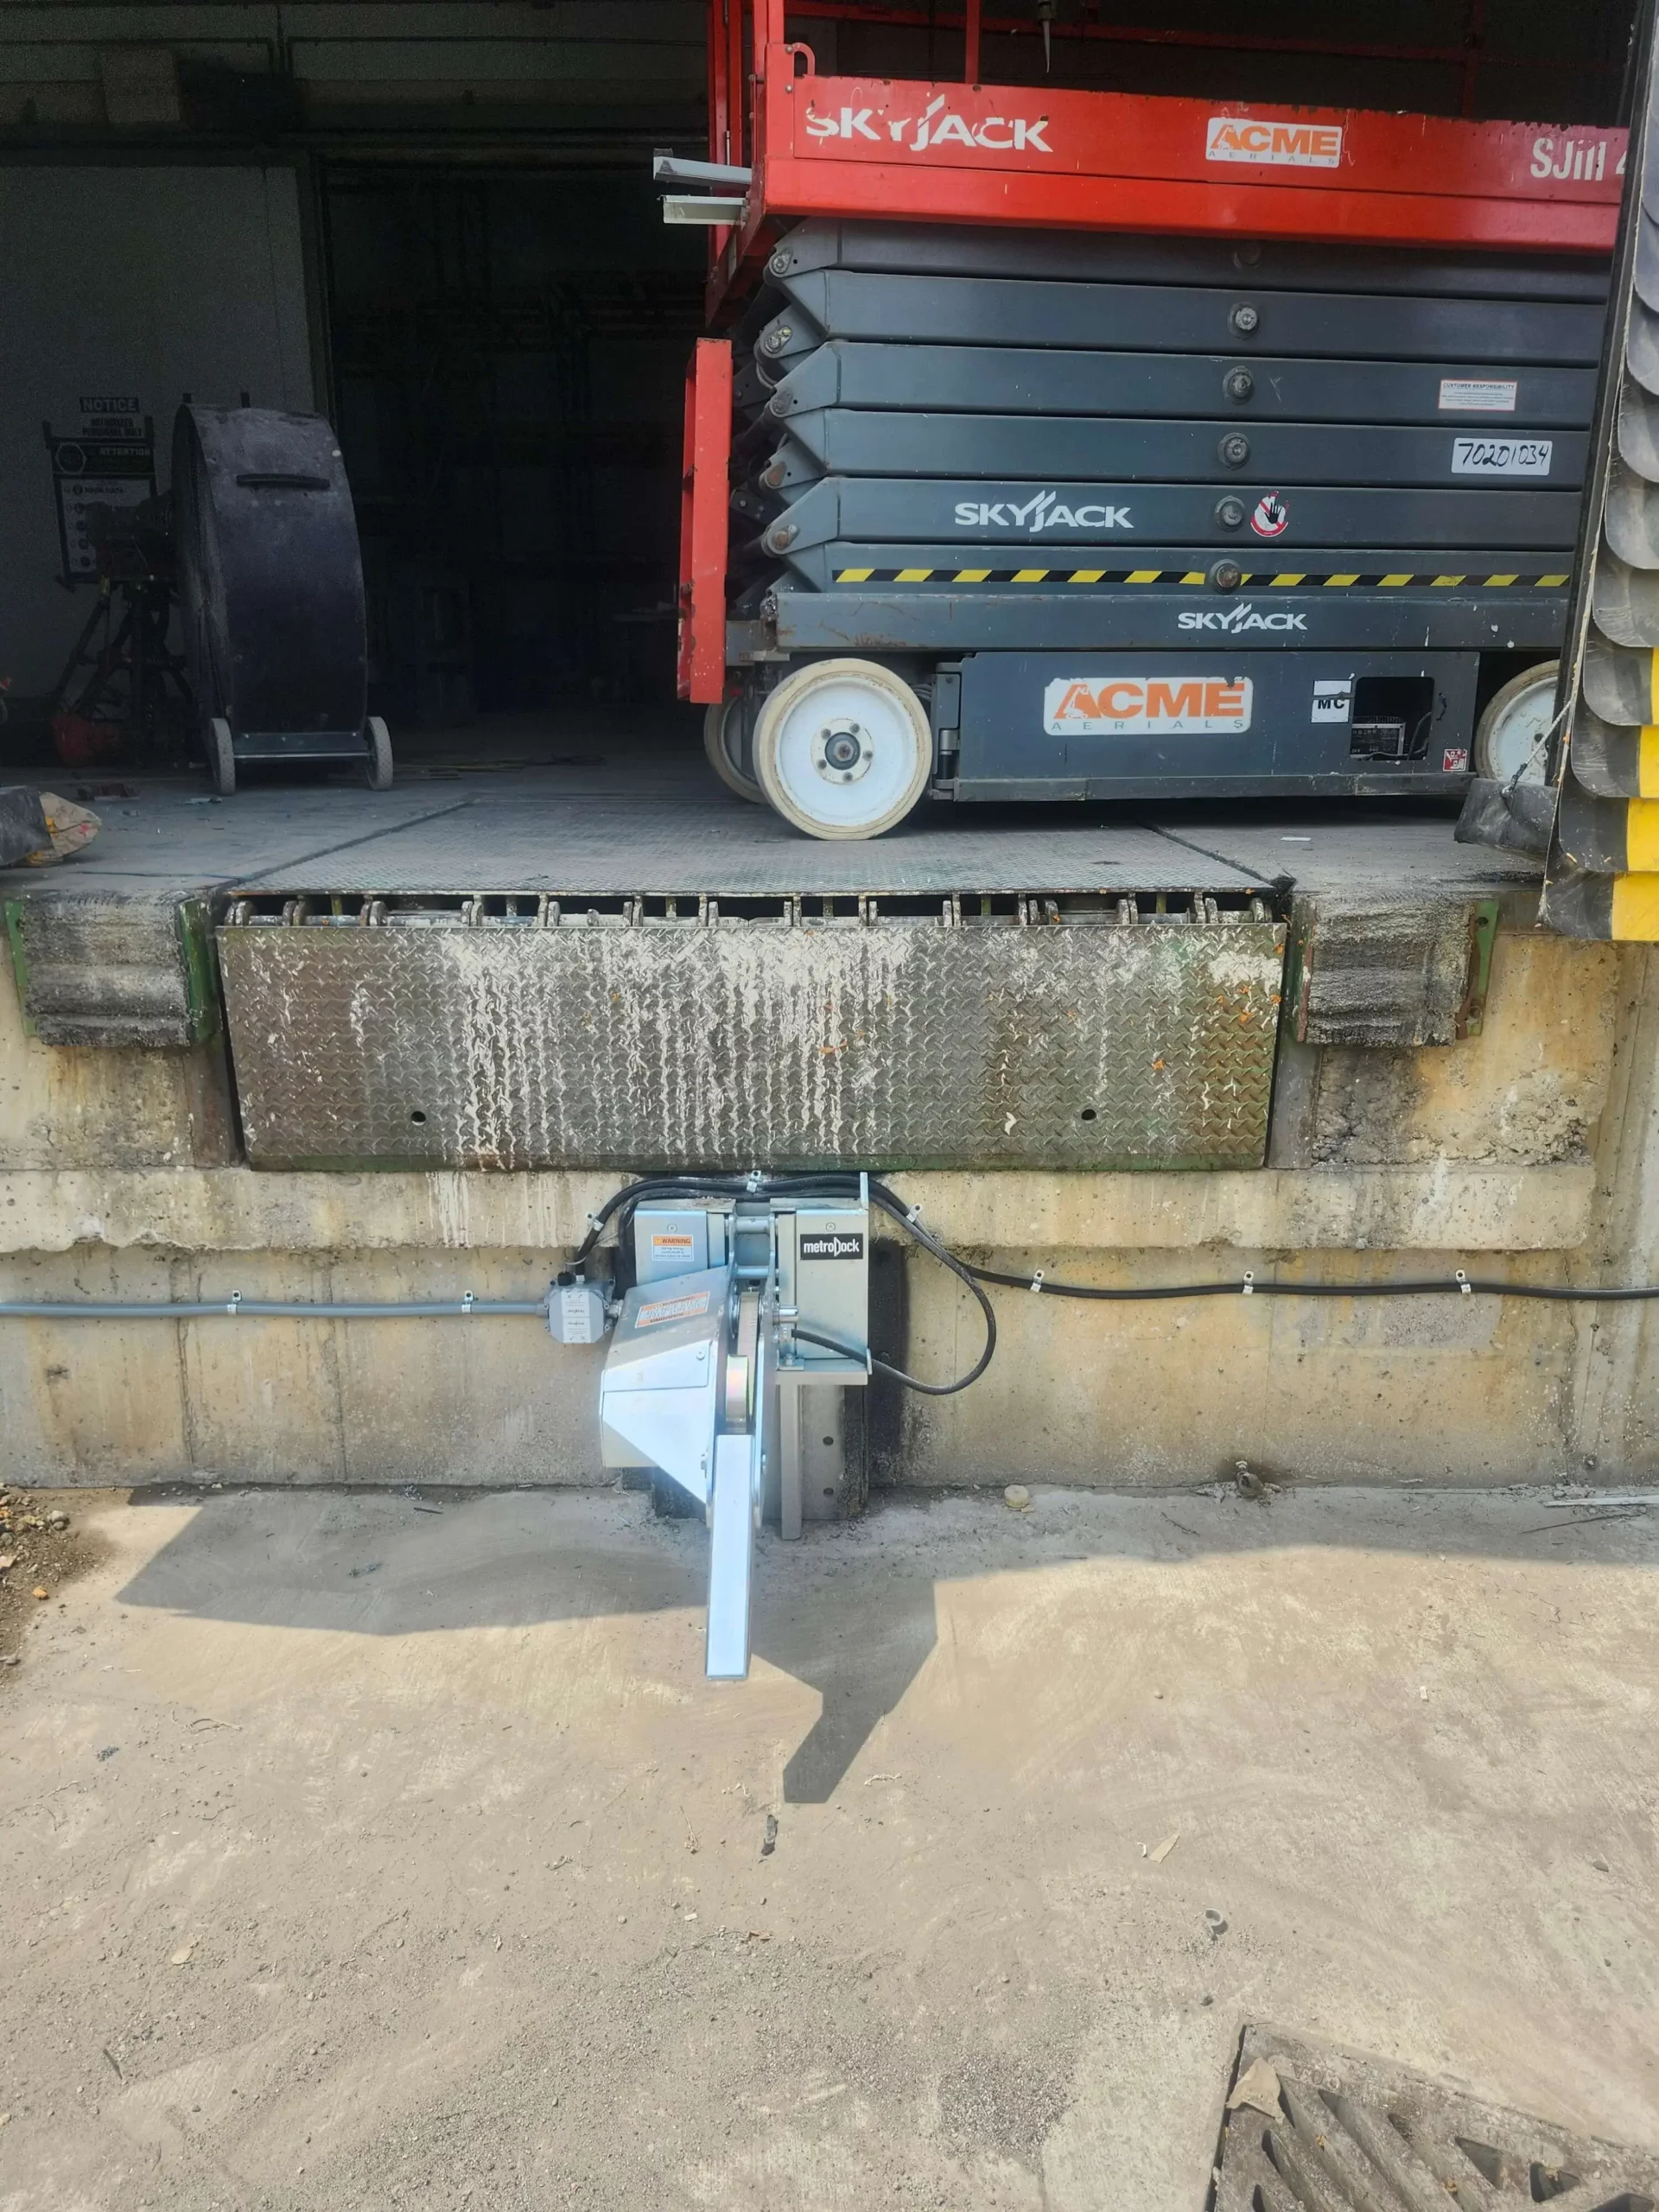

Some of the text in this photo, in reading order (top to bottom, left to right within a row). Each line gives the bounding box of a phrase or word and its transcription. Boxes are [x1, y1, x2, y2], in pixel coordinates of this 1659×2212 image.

[806, 93, 1053, 152] SKYJACK
[1211, 124, 1338, 156] ACME
[1209, 150, 1334, 165] AERIALS
[83, 398, 136, 411] NOTICE
[1458, 442, 1549, 467] 70201034
[954, 490, 1135, 533] SKYJACK
[1178, 602, 1309, 634] SKYJACK
[1053, 683, 1245, 719] ACME
[1318, 699, 1345, 709] MC
[1052, 720, 1243, 731] AERIALS
[804, 1236, 860, 1257] metroDock
